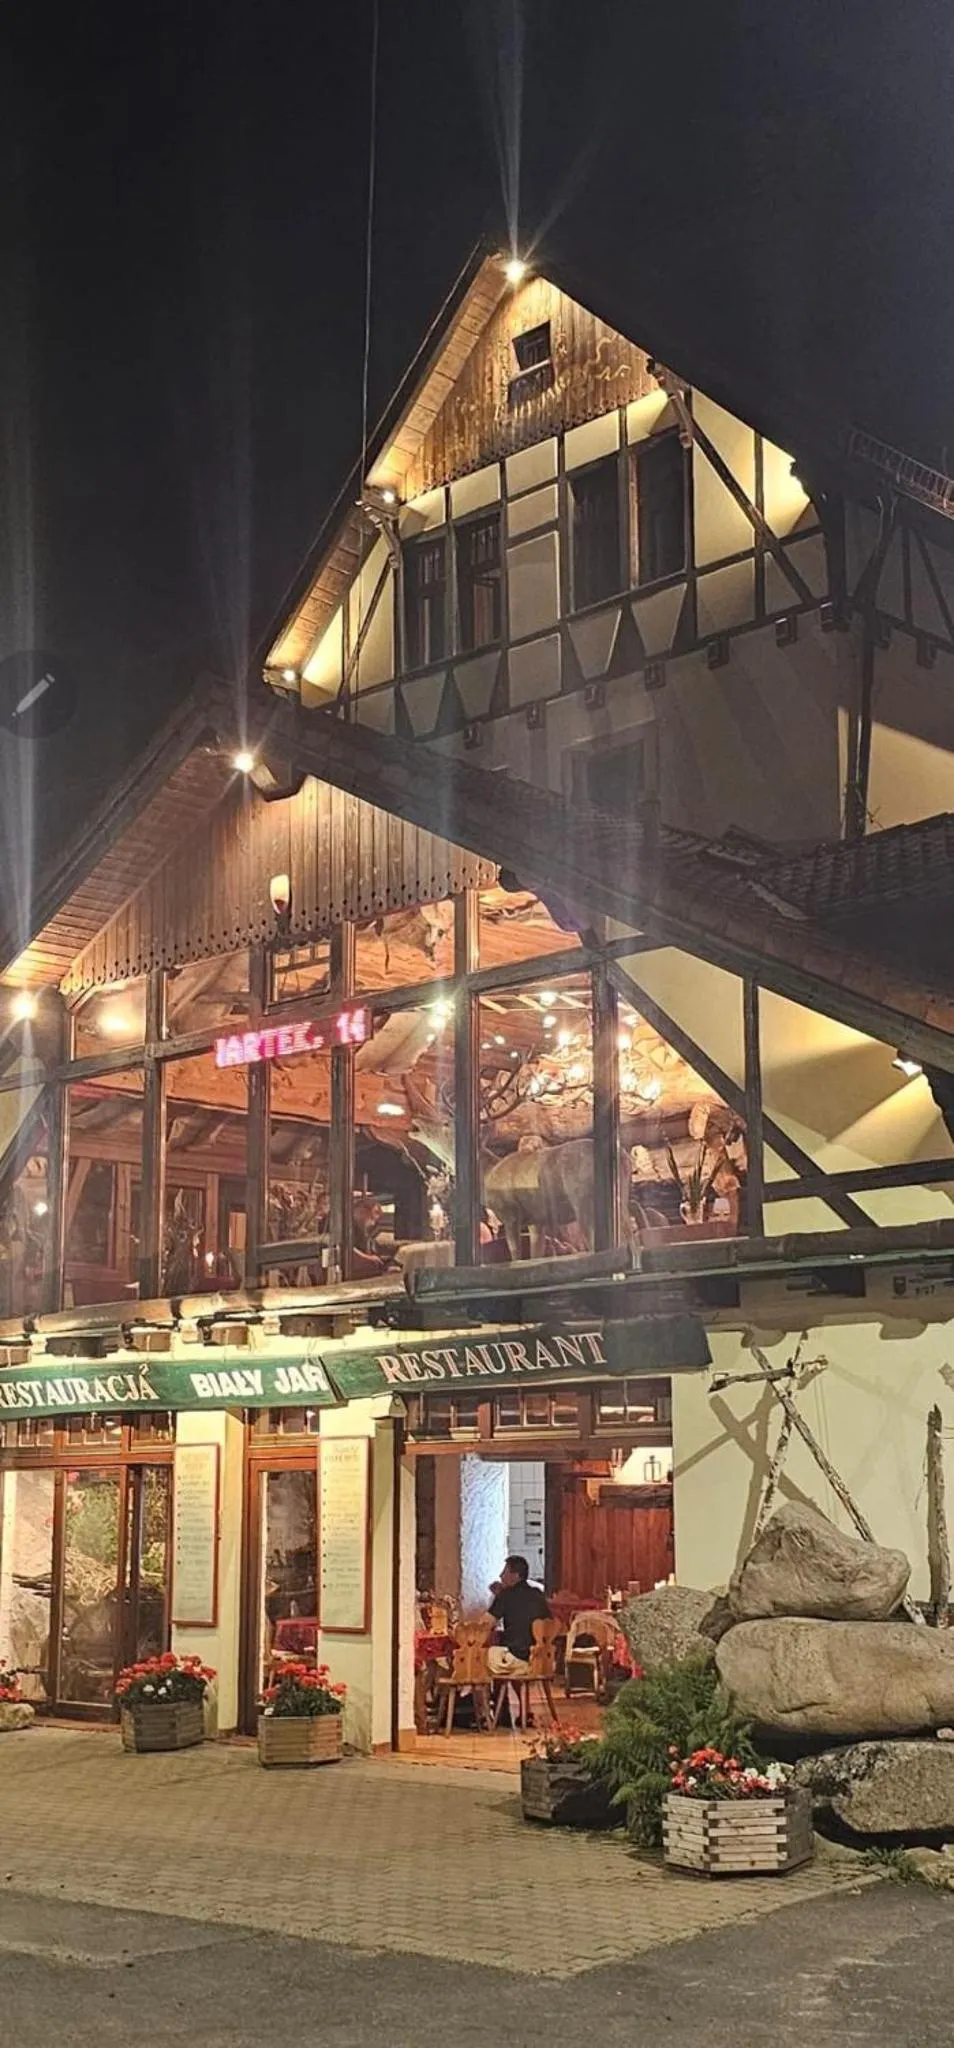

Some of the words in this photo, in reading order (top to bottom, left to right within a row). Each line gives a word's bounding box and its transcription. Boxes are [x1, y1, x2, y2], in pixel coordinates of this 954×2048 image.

[375, 1333, 608, 1385] RESTAURANT
[190, 1369, 264, 1397] BIAŁY
[274, 1364, 329, 1394] JAR
